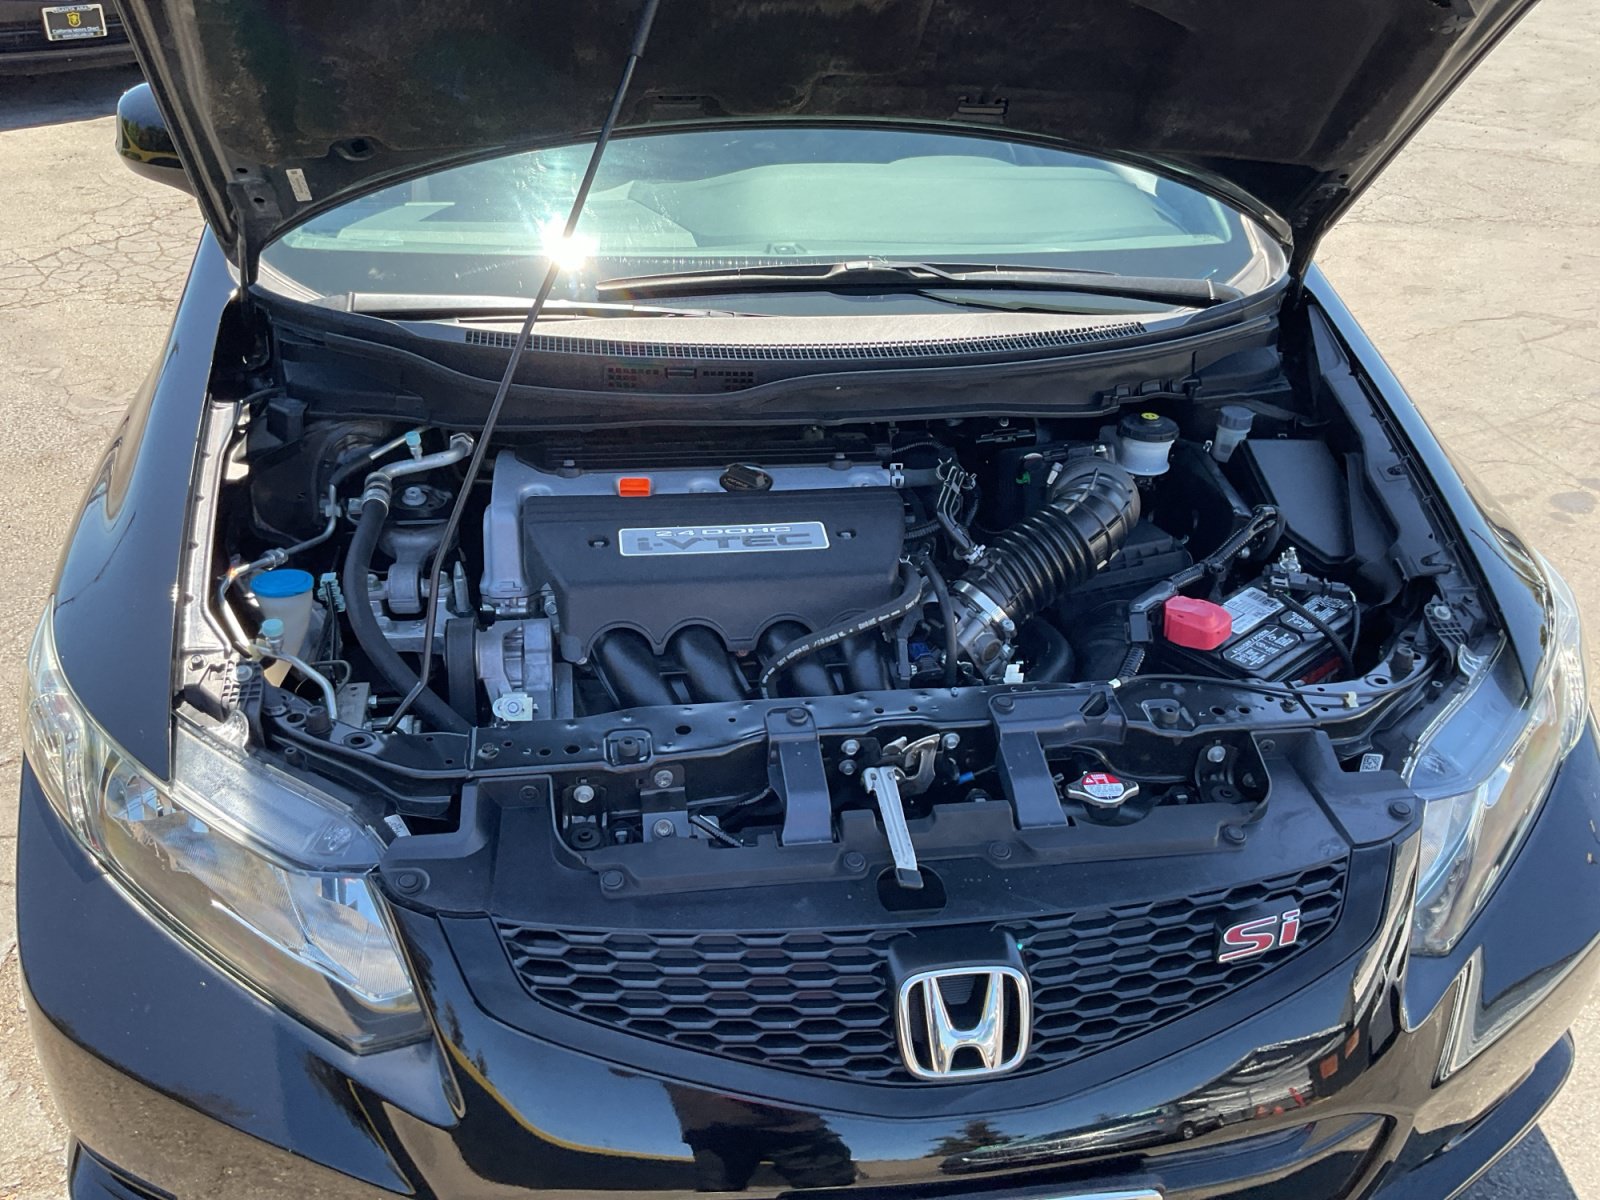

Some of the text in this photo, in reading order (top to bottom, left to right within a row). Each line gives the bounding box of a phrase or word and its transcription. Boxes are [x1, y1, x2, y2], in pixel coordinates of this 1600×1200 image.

[655, 526, 791, 537] 2.4 DOHC
[637, 533, 812, 551] i-VTEC
[1219, 908, 1300, 962] Si
